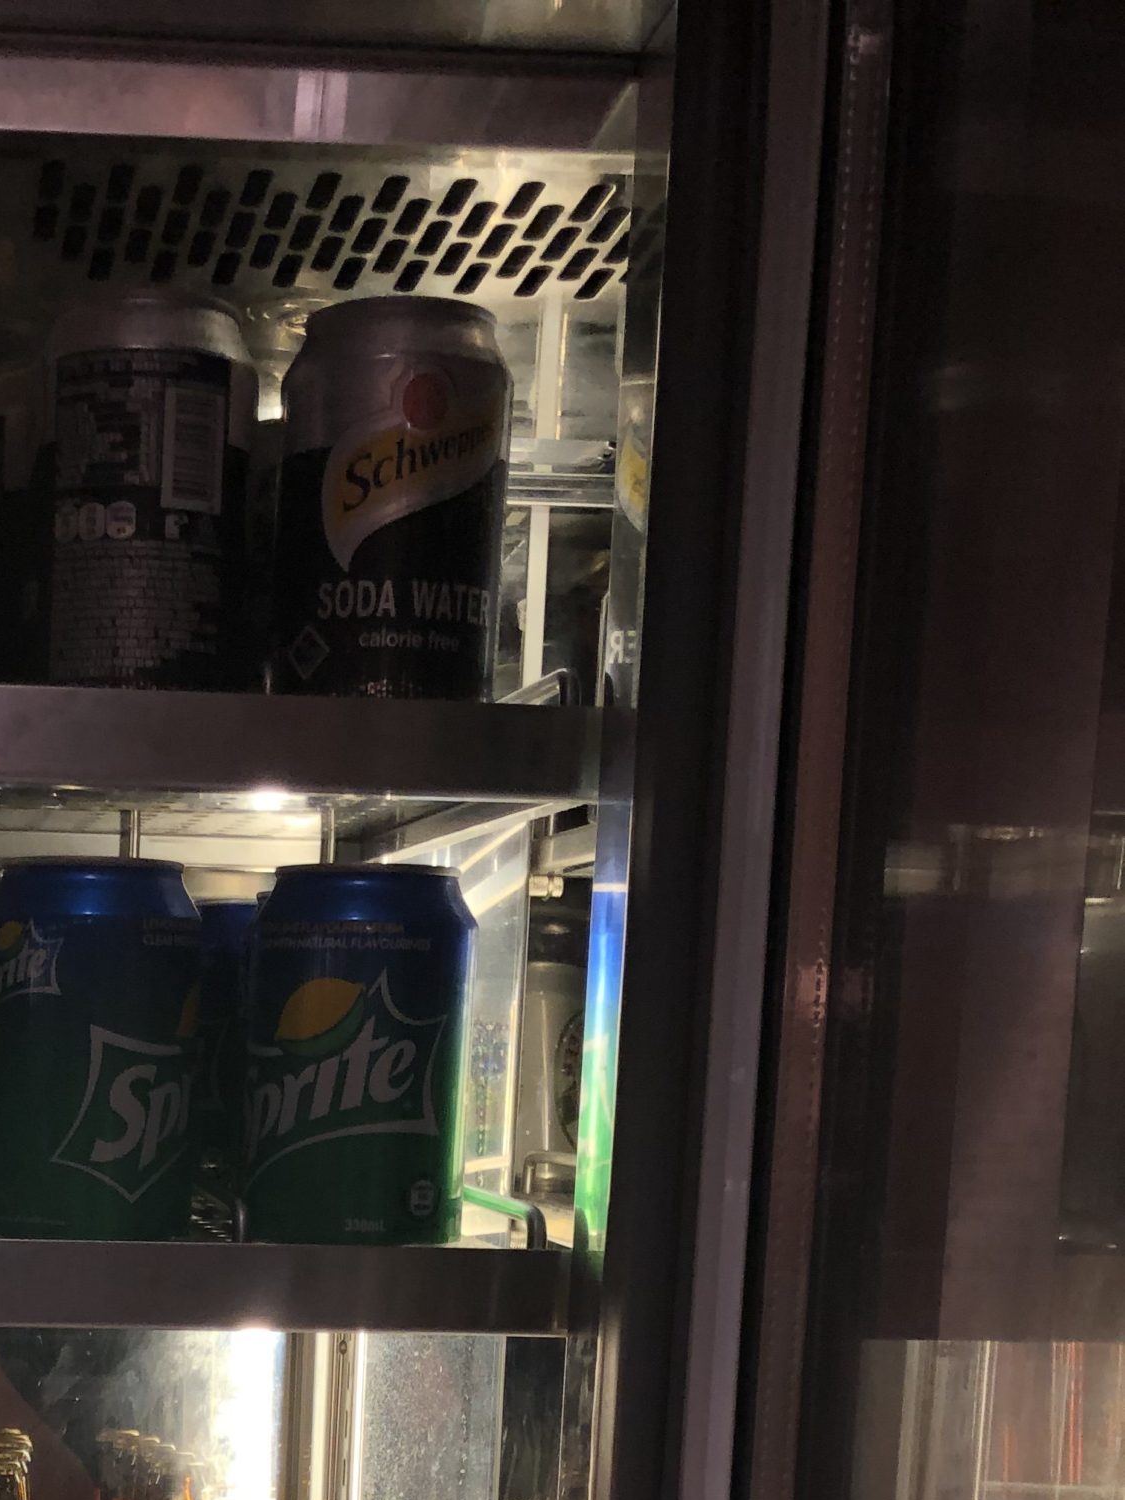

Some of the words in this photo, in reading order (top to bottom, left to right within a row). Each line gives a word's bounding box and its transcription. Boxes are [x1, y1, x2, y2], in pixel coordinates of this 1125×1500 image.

[316, 578, 397, 620] SODA
[411, 580, 491, 627] WATER
[357, 628, 423, 651] calorie
[426, 630, 461, 652] free
[246, 1015, 418, 1160] prite
